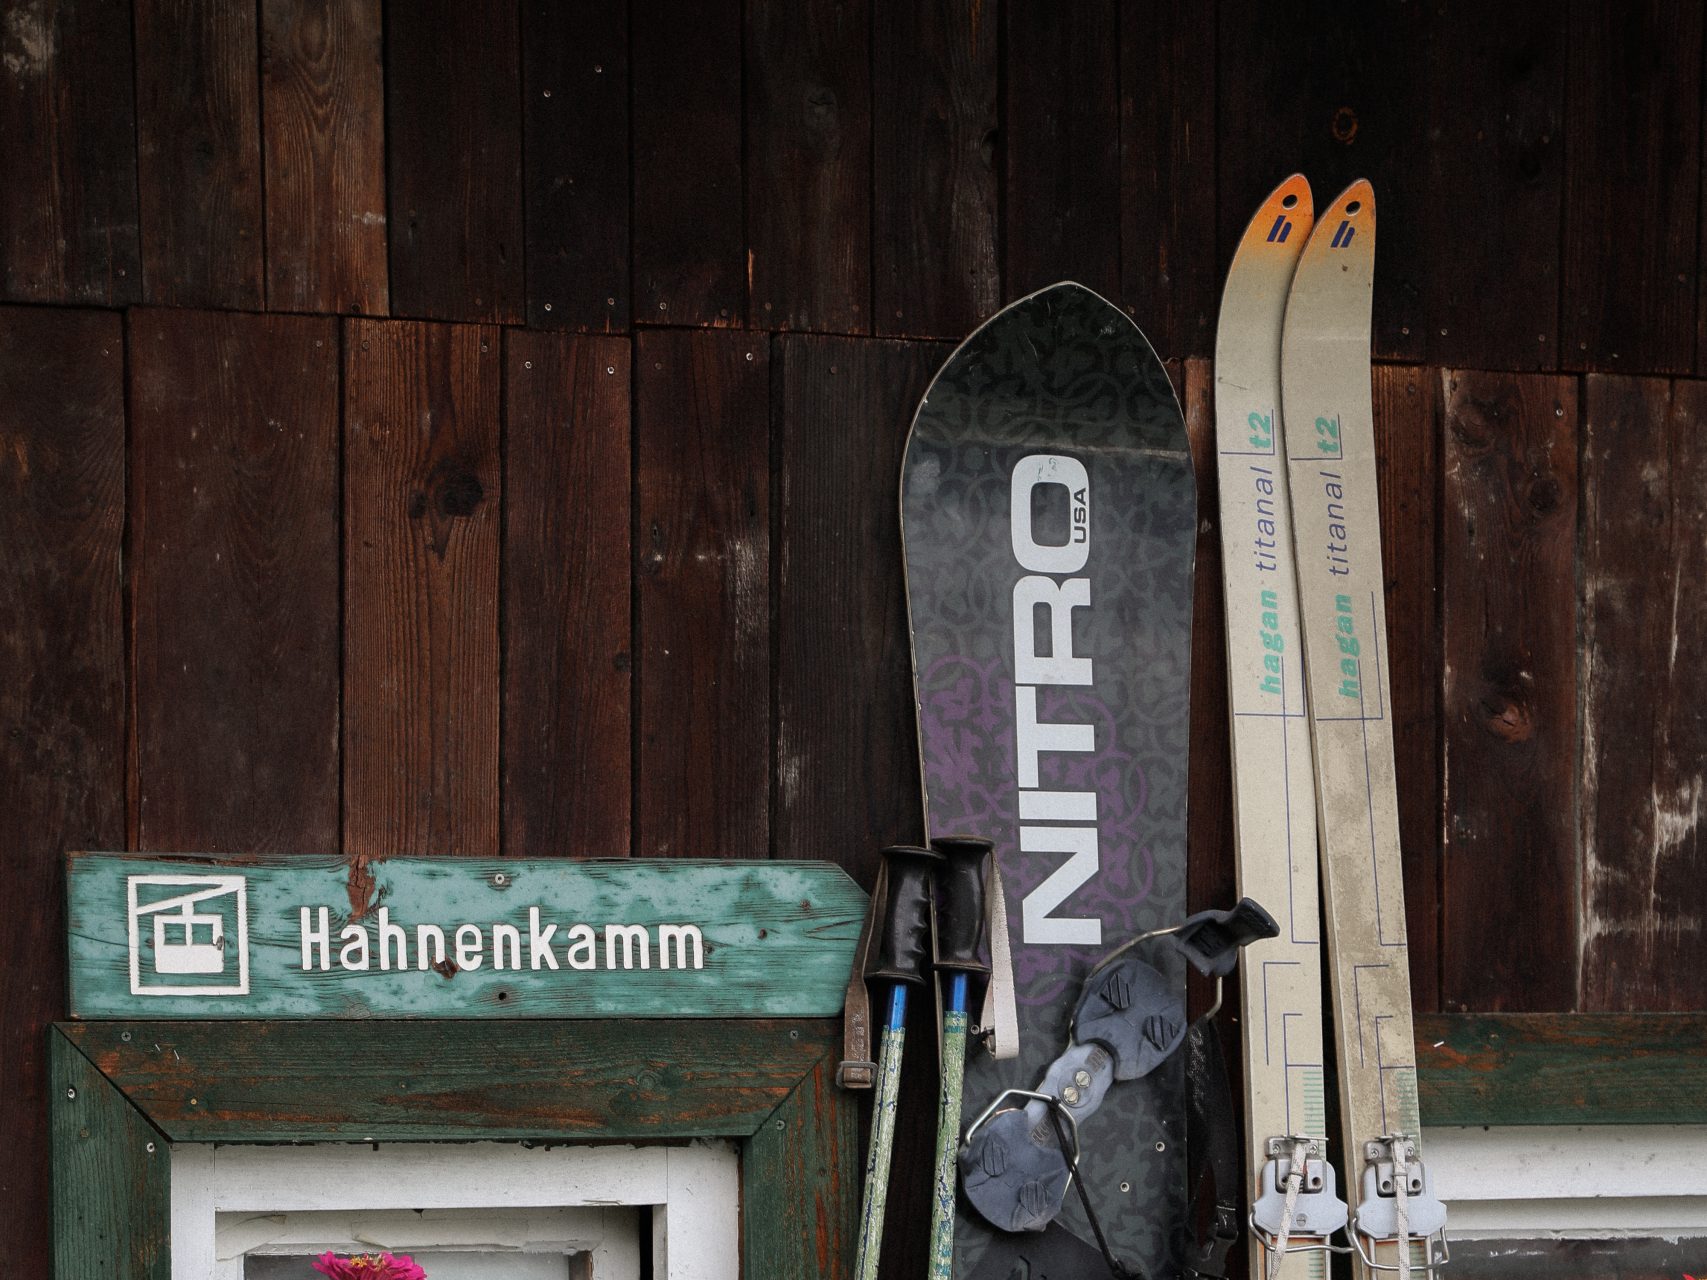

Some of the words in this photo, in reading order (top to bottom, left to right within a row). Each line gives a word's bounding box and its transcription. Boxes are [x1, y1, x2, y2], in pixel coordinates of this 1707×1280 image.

[1248, 411, 1272, 450] t2
[1315, 416, 1339, 455] t2
[1073, 487, 1087, 544] USA
[1250, 466, 1277, 572] titanal
[1319, 471, 1349, 577] titanal
[1260, 590, 1284, 696] hagan
[1335, 592, 1360, 700] hagan
[1010, 454, 1102, 945] NITRO
[299, 906, 705, 972] Hahnenkamm
